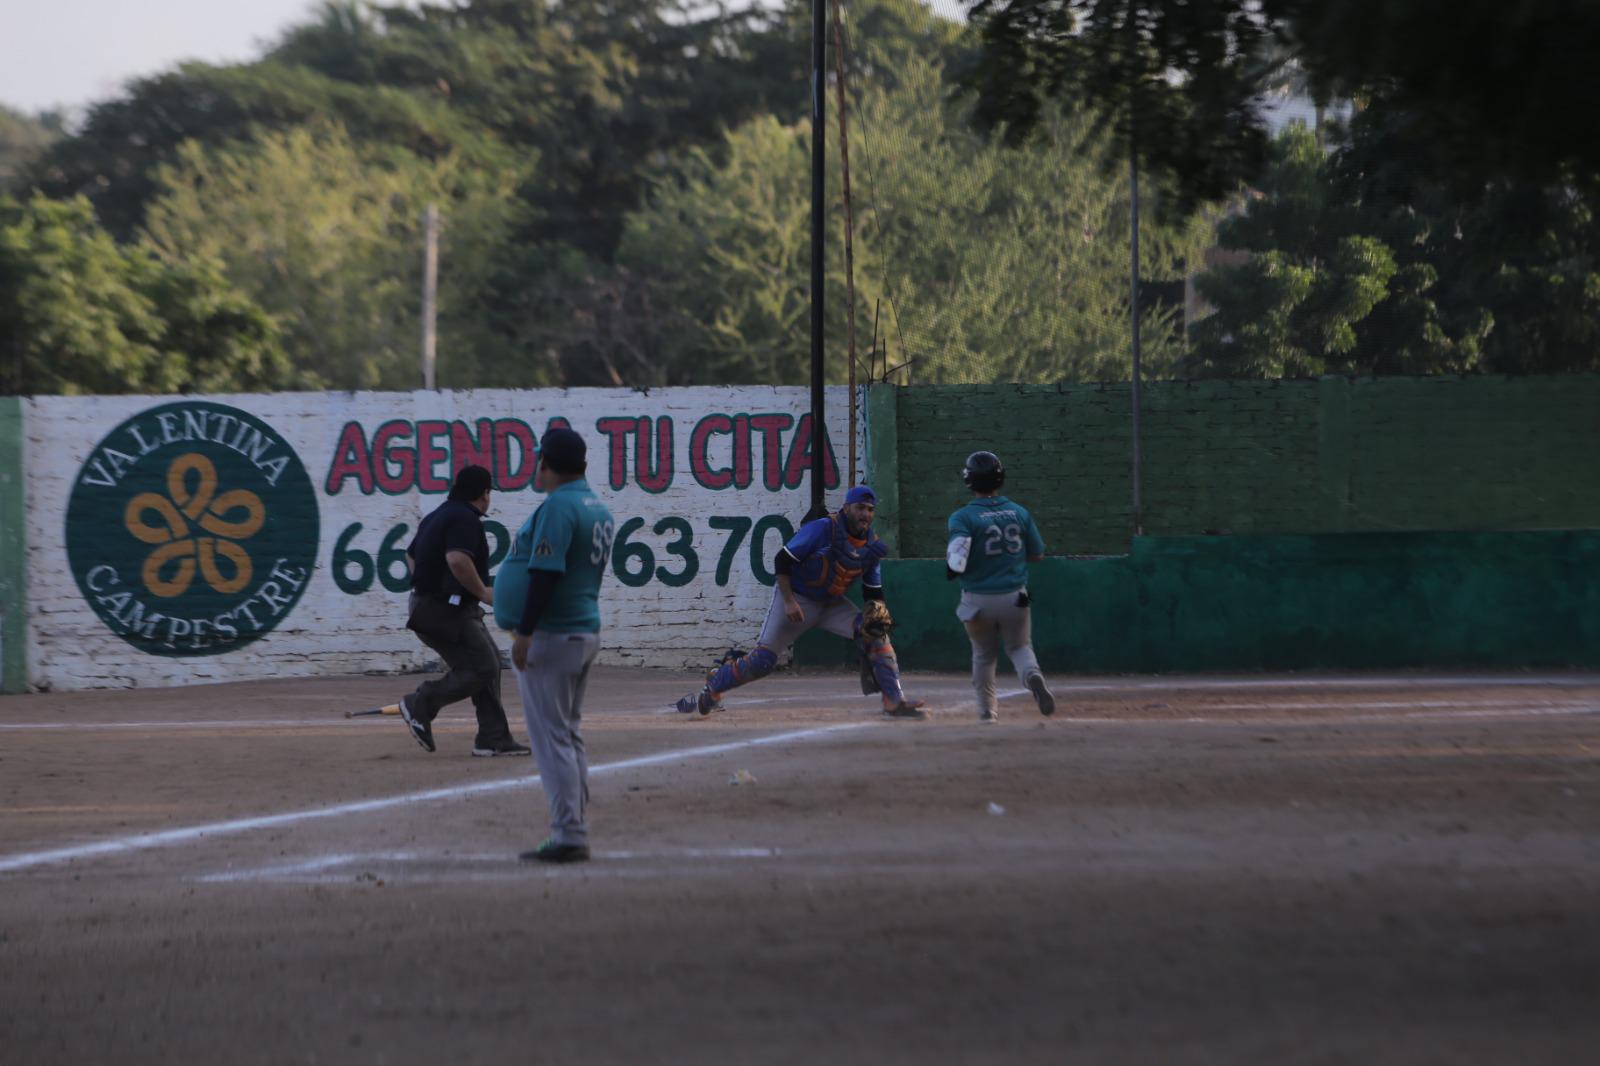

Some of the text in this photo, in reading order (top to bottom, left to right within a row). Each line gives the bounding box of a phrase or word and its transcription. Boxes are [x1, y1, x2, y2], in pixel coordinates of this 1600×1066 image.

[81, 409, 291, 488] VALENTINA
[596, 414, 675, 494] TU
[689, 412, 841, 493] CITA
[984, 523, 1023, 556] 29
[85, 557, 306, 649] CAMPESTRE
